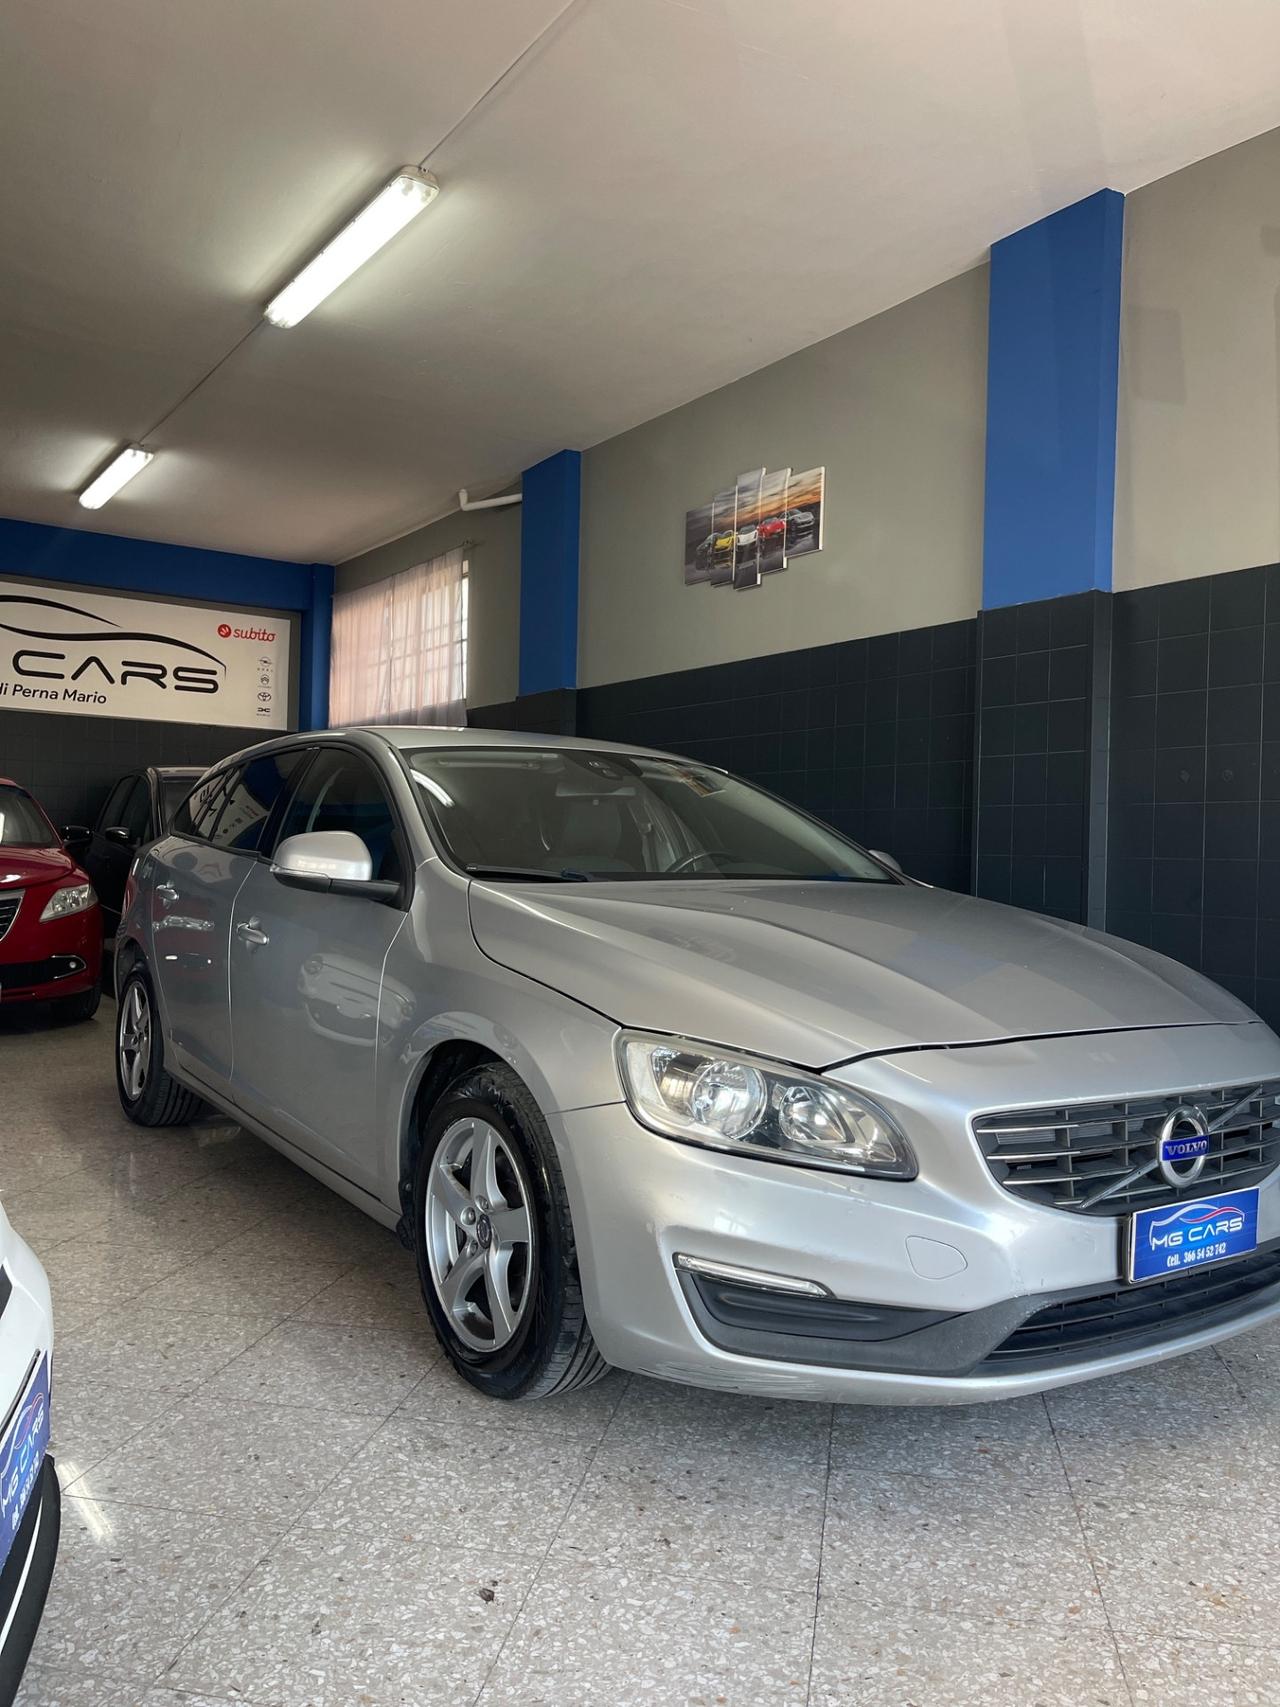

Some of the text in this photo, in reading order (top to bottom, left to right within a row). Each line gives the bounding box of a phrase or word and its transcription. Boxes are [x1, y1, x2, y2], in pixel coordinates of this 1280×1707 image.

[233, 627, 276, 642] subito
[12, 649, 219, 694] CARS
[12, 683, 59, 700] Perna
[62, 689, 107, 704] Mario
[1165, 1139, 1208, 1156] VOLVO
[1152, 1217, 1242, 1251] MG CARS
[1183, 1250, 1196, 1263] 366
[1196, 1247, 1205, 1260] 54
[1205, 1245, 1214, 1258] 52
[1215, 1242, 1227, 1255] 742
